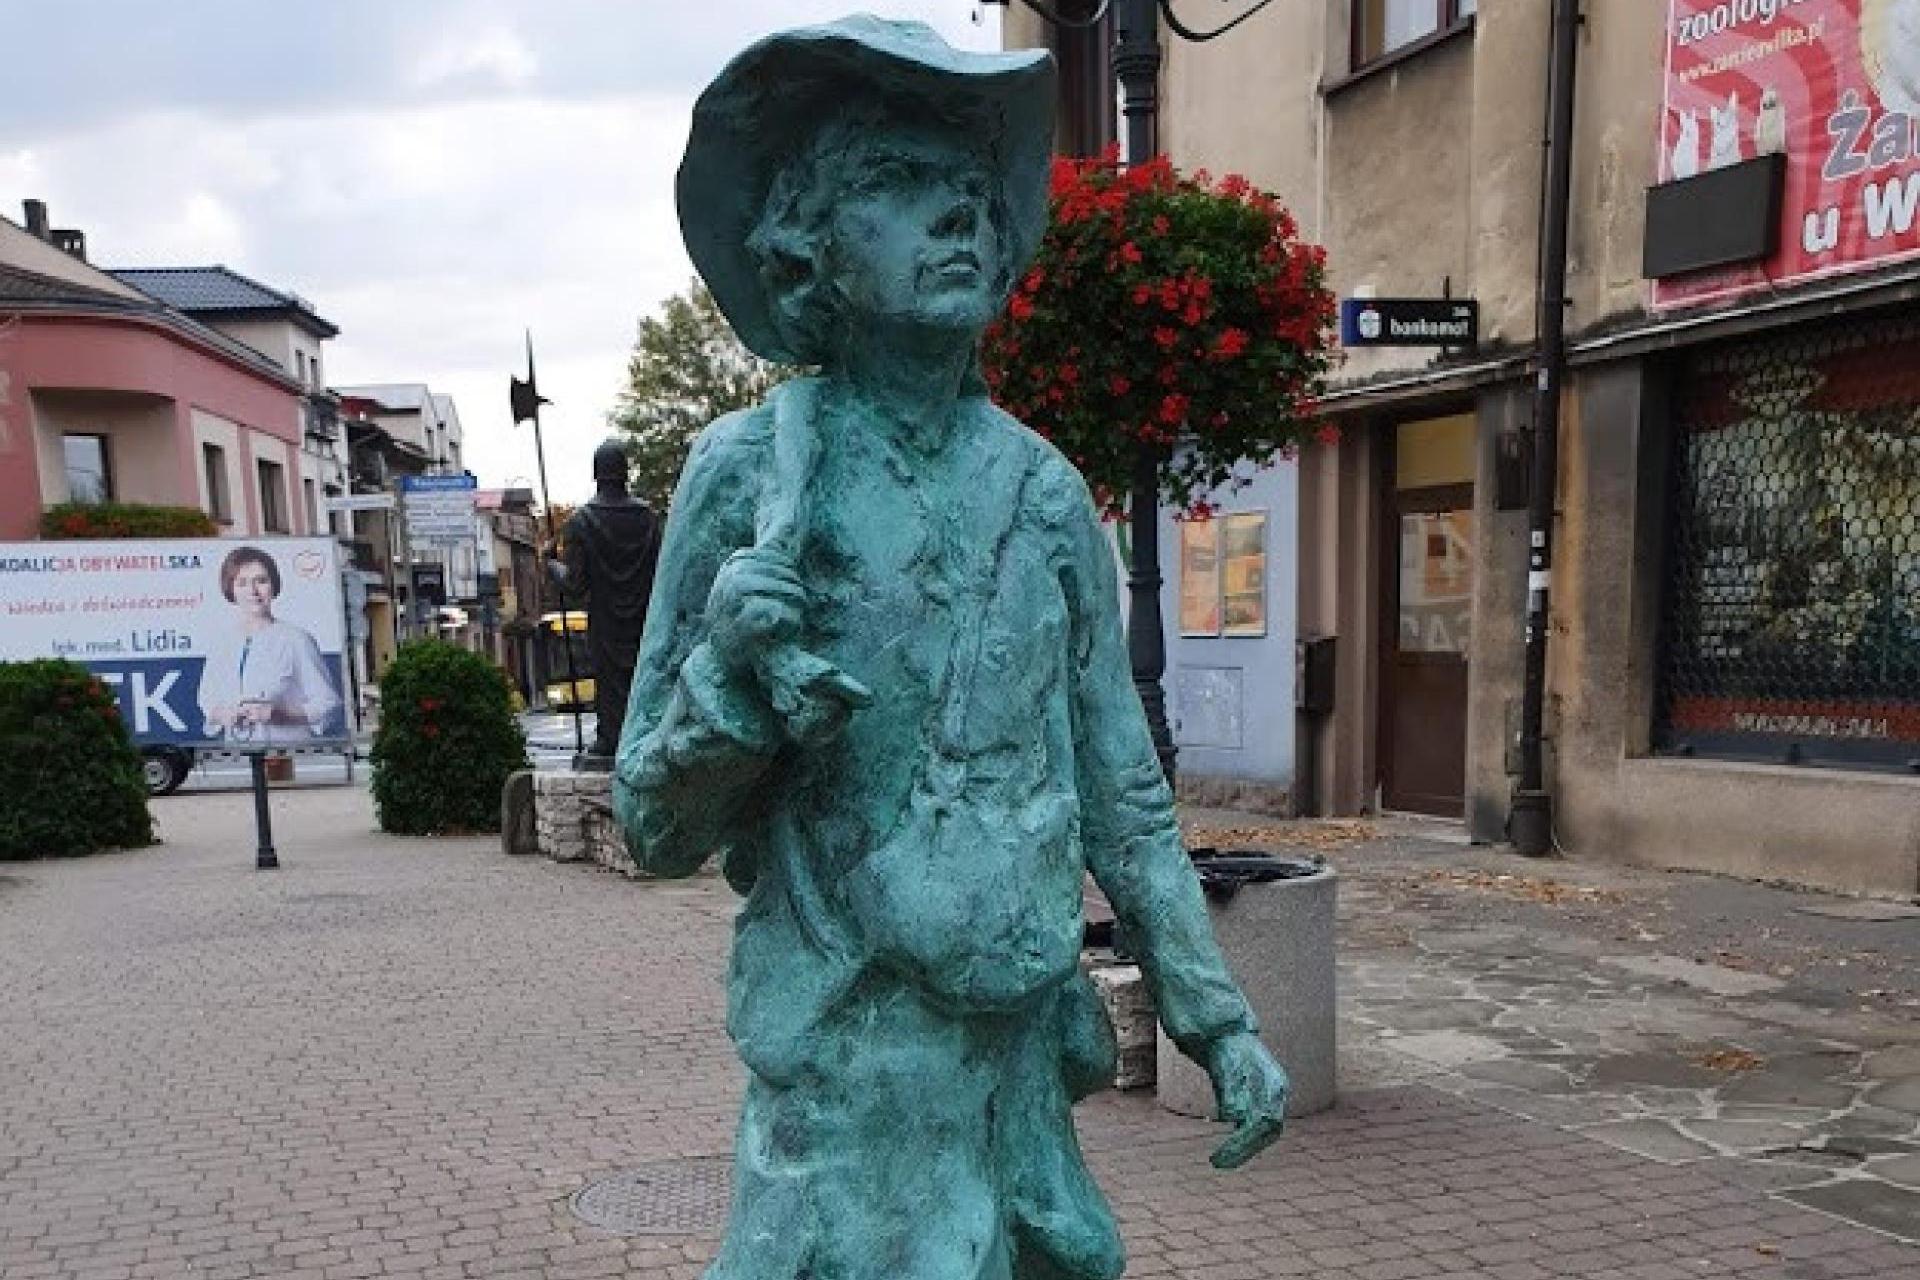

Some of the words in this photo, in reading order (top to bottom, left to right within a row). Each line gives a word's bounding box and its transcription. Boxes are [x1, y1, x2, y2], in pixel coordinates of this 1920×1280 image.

[1823, 87, 1920, 181] Ża
[1802, 205, 1841, 254] u
[79, 555, 201, 572] OBYWATELSKA
[131, 629, 192, 652] Lidia
